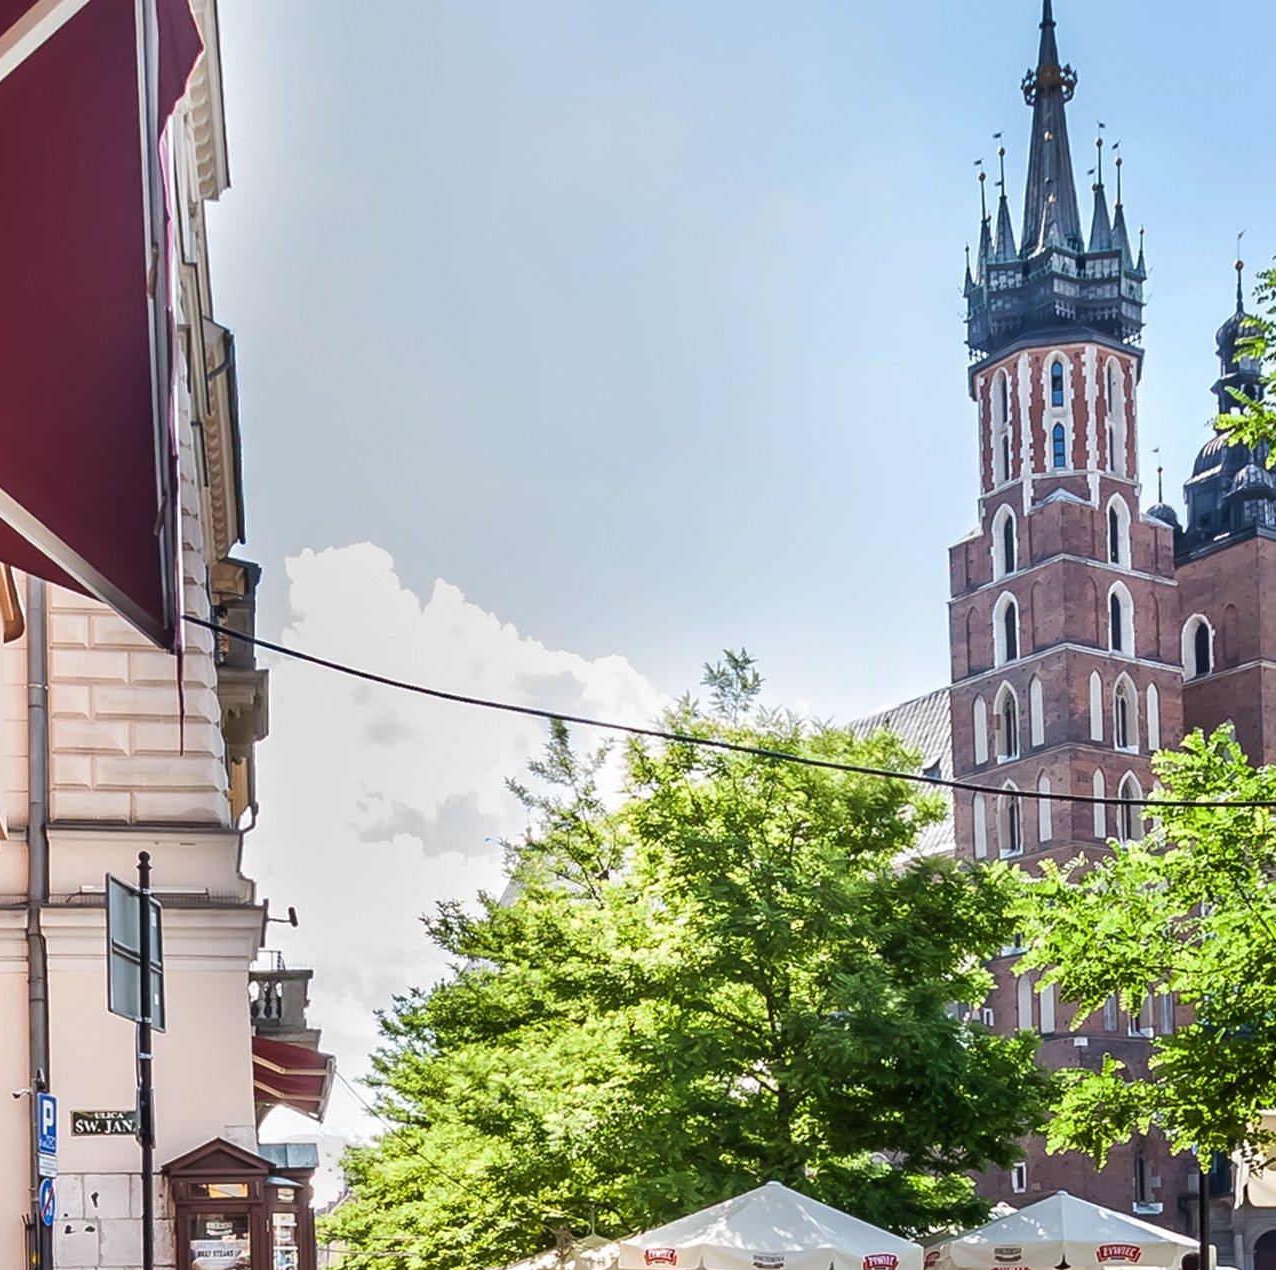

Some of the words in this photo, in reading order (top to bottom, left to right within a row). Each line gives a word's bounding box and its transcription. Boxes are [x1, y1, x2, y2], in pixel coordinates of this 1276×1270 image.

[43, 1100, 54, 1135] P
[75, 1119, 101, 1133] ŚW.
[104, 1120, 137, 1133] JAN
